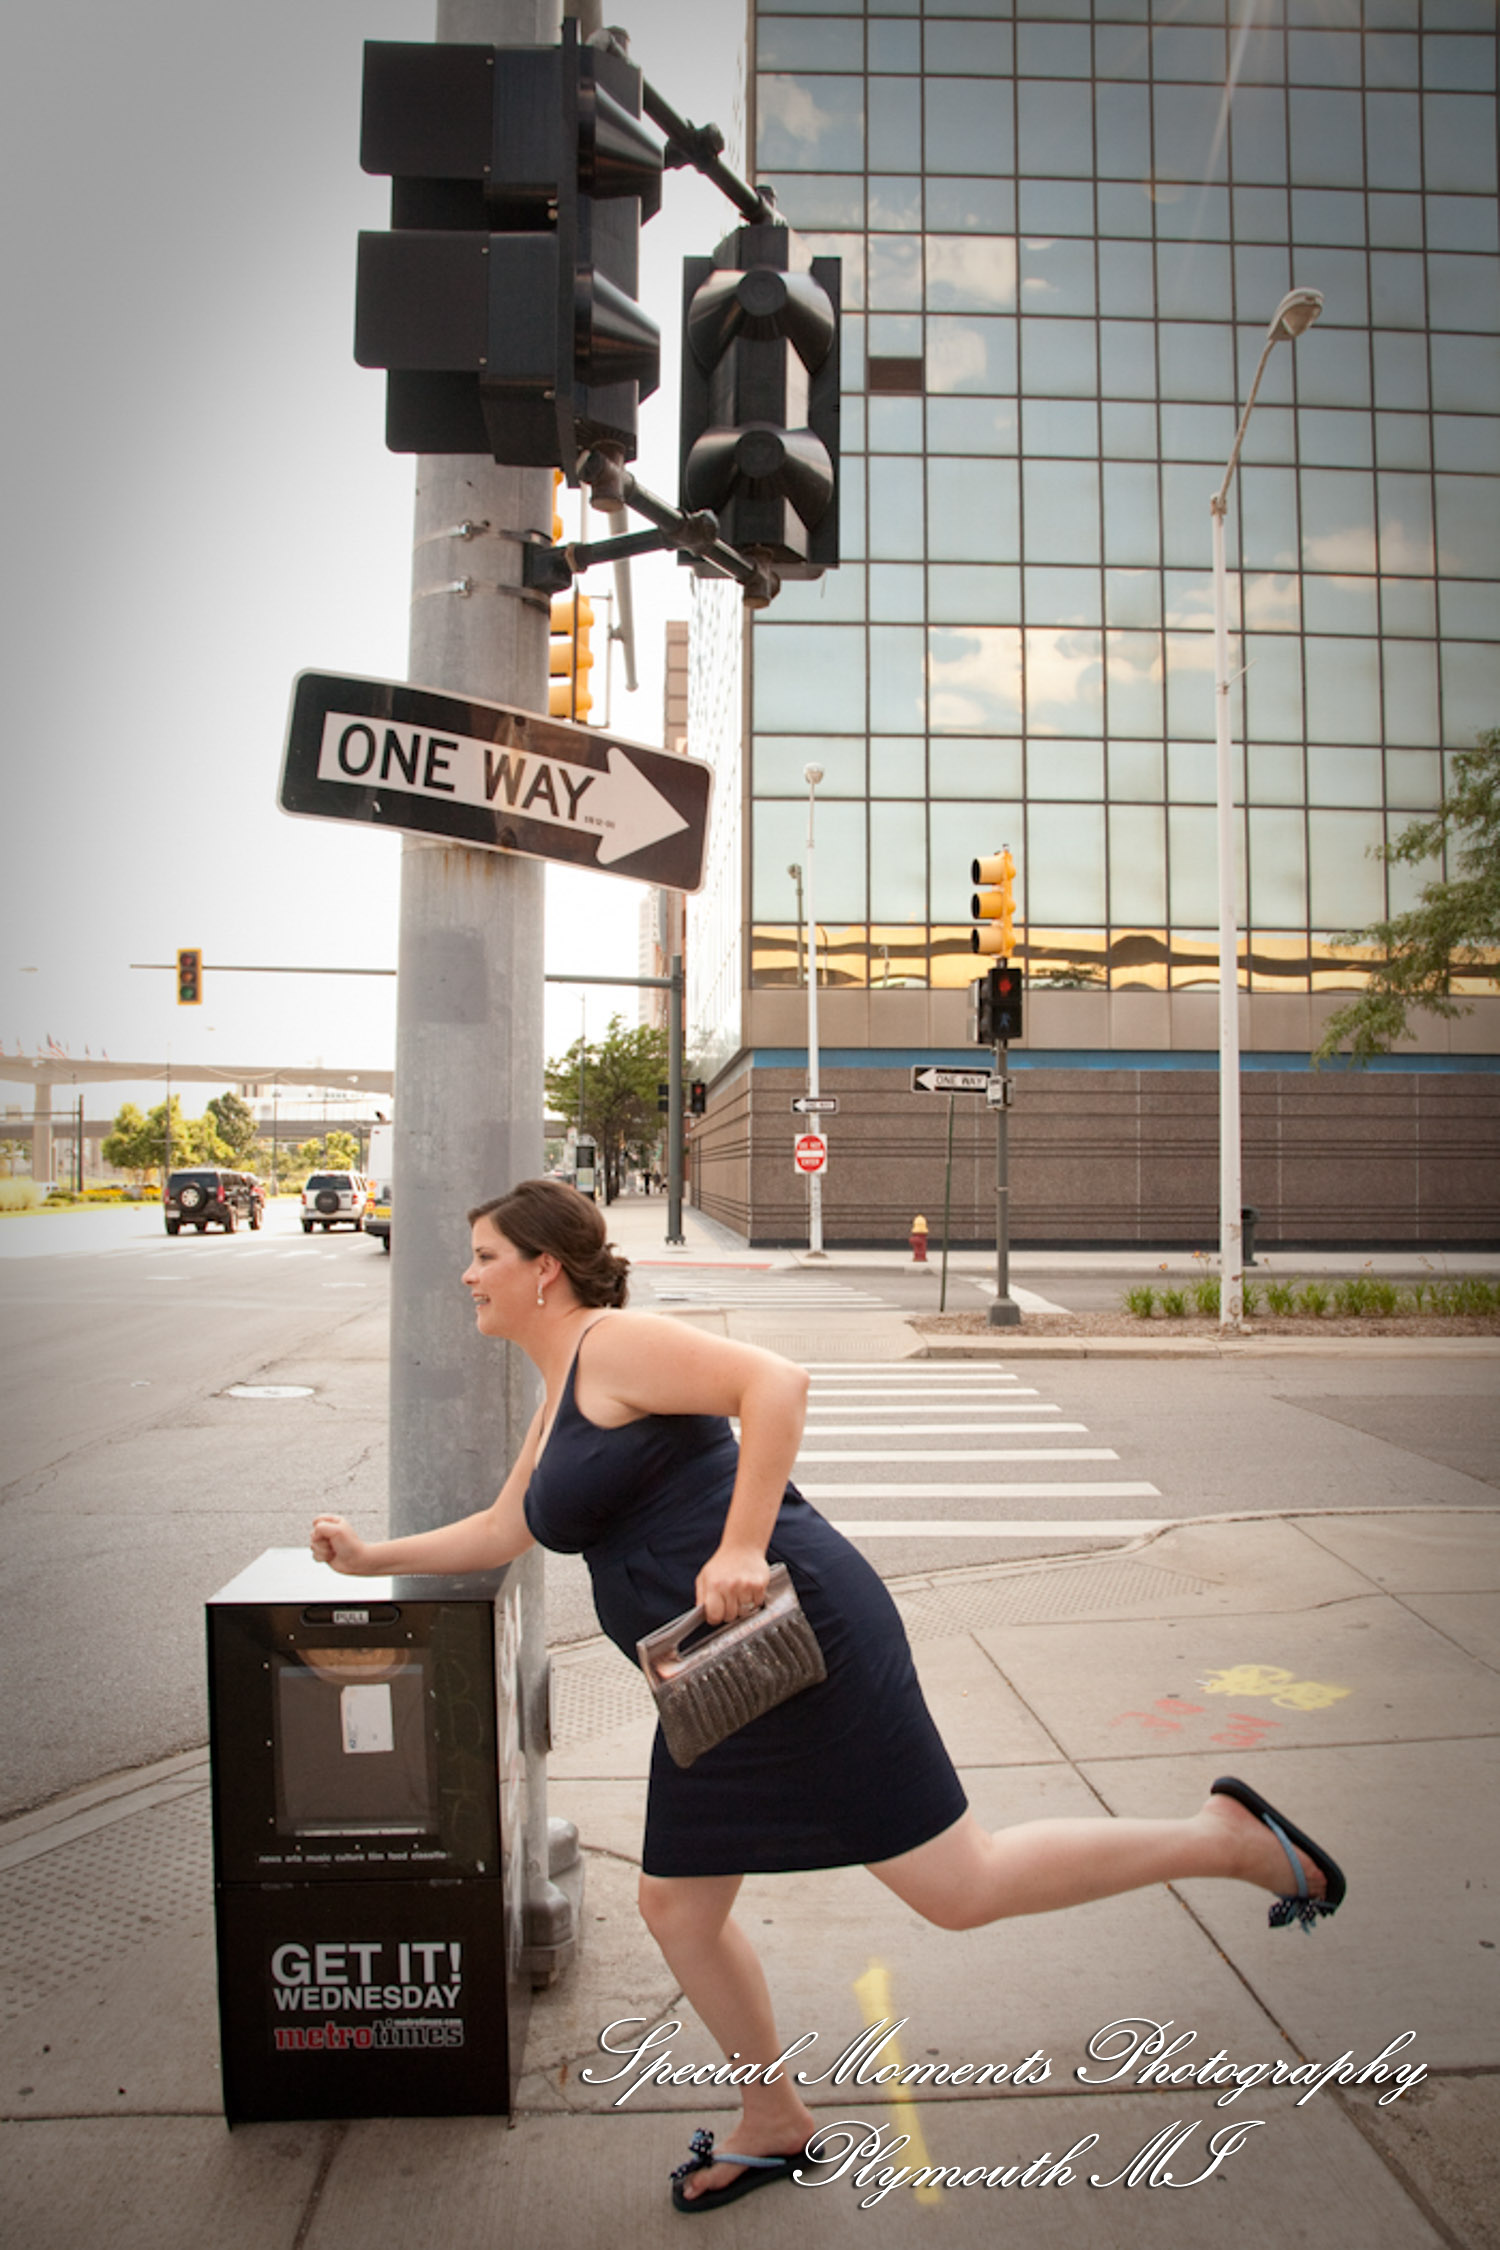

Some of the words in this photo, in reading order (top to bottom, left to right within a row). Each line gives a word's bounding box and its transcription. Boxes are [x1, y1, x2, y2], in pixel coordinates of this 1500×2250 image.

[337, 723, 459, 793] ONE
[483, 748, 596, 822] WAY
[936, 1075, 956, 1086] ONE
[961, 1076, 983, 1086] WAY
[800, 1141, 808, 1150] DO
[810, 1141, 821, 1150] NOT
[801, 1158, 820, 1166] ENTER
[335, 1612, 367, 1623] PULL
[259, 1855, 282, 1863] news
[285, 1854, 302, 1863] arts
[305, 1853, 332, 1863] music
[334, 1853, 365, 1862] culture
[270, 1943, 382, 1985] GET
[399, 1942, 462, 1984] IT!
[273, 1985, 461, 2011] WEDNESDAY
